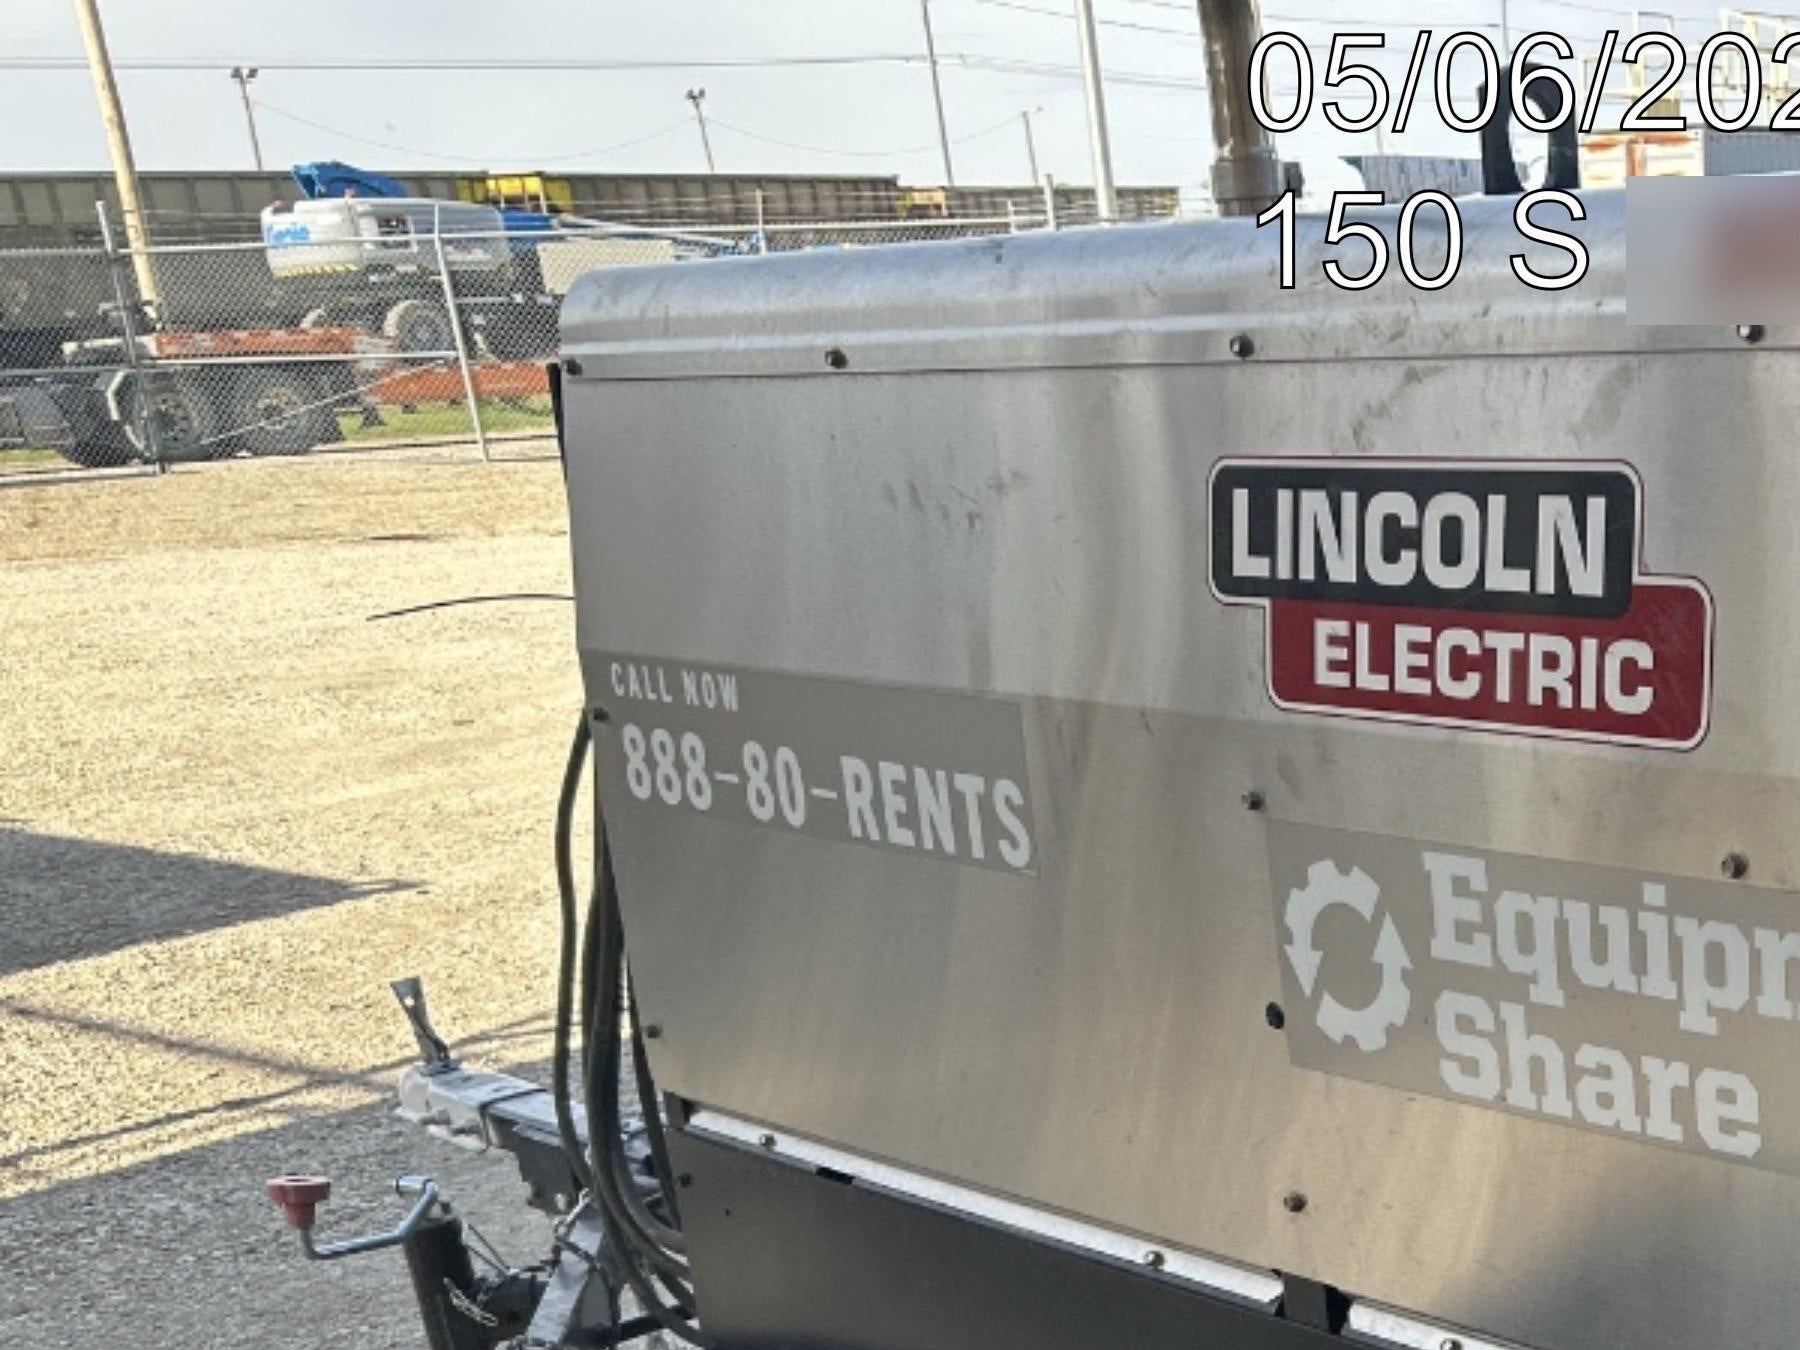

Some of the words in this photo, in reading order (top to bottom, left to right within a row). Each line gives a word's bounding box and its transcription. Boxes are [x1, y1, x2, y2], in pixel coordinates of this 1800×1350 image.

[1231, 487, 1607, 598] LINCOLN
[611, 661, 674, 703] CALL
[682, 668, 739, 712] NOW
[1314, 617, 1655, 716] ELECTRIC
[622, 723, 1031, 869] 888-80-RENTS
[1434, 988, 1764, 1160] Share
